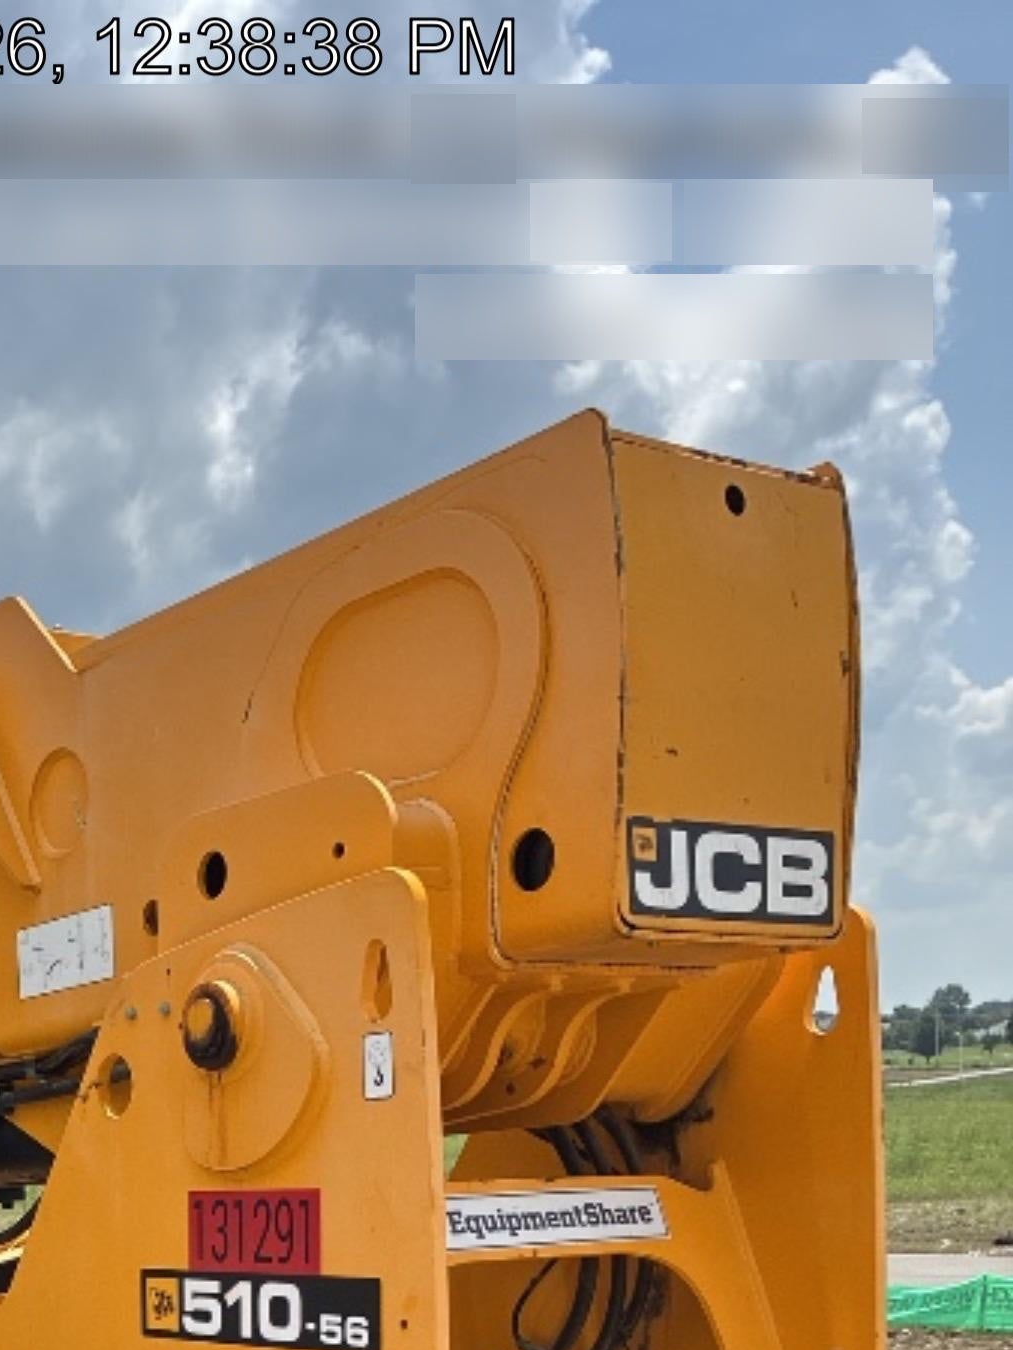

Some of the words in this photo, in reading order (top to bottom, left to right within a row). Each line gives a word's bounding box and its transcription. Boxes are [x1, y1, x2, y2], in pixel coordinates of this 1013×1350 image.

[634, 829, 829, 917] JCB
[194, 1198, 310, 1265] 131291
[446, 1203, 654, 1240] EquipmentShare
